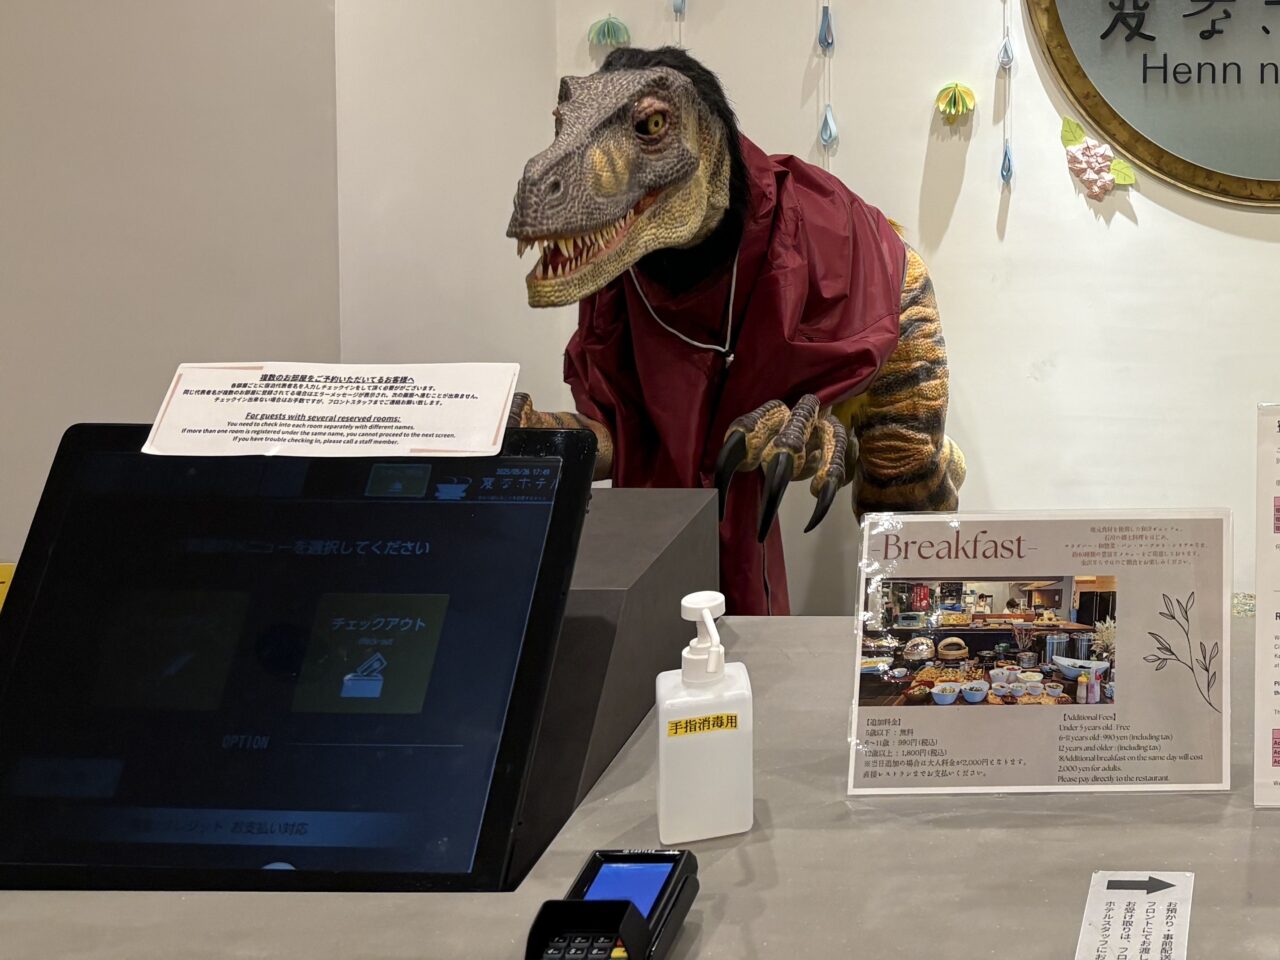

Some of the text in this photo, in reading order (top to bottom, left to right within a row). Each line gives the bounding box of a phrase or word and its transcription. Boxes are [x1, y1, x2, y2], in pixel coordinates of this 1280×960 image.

[1142, 53, 1242, 85] Henn
[244, 412, 259, 420] For
[332, 618, 426, 632] チェックアウト
[670, 715, 737, 734] 手指消毒用
[222, 736, 270, 749] OPTION
[231, 821, 308, 835] お支払い対応
